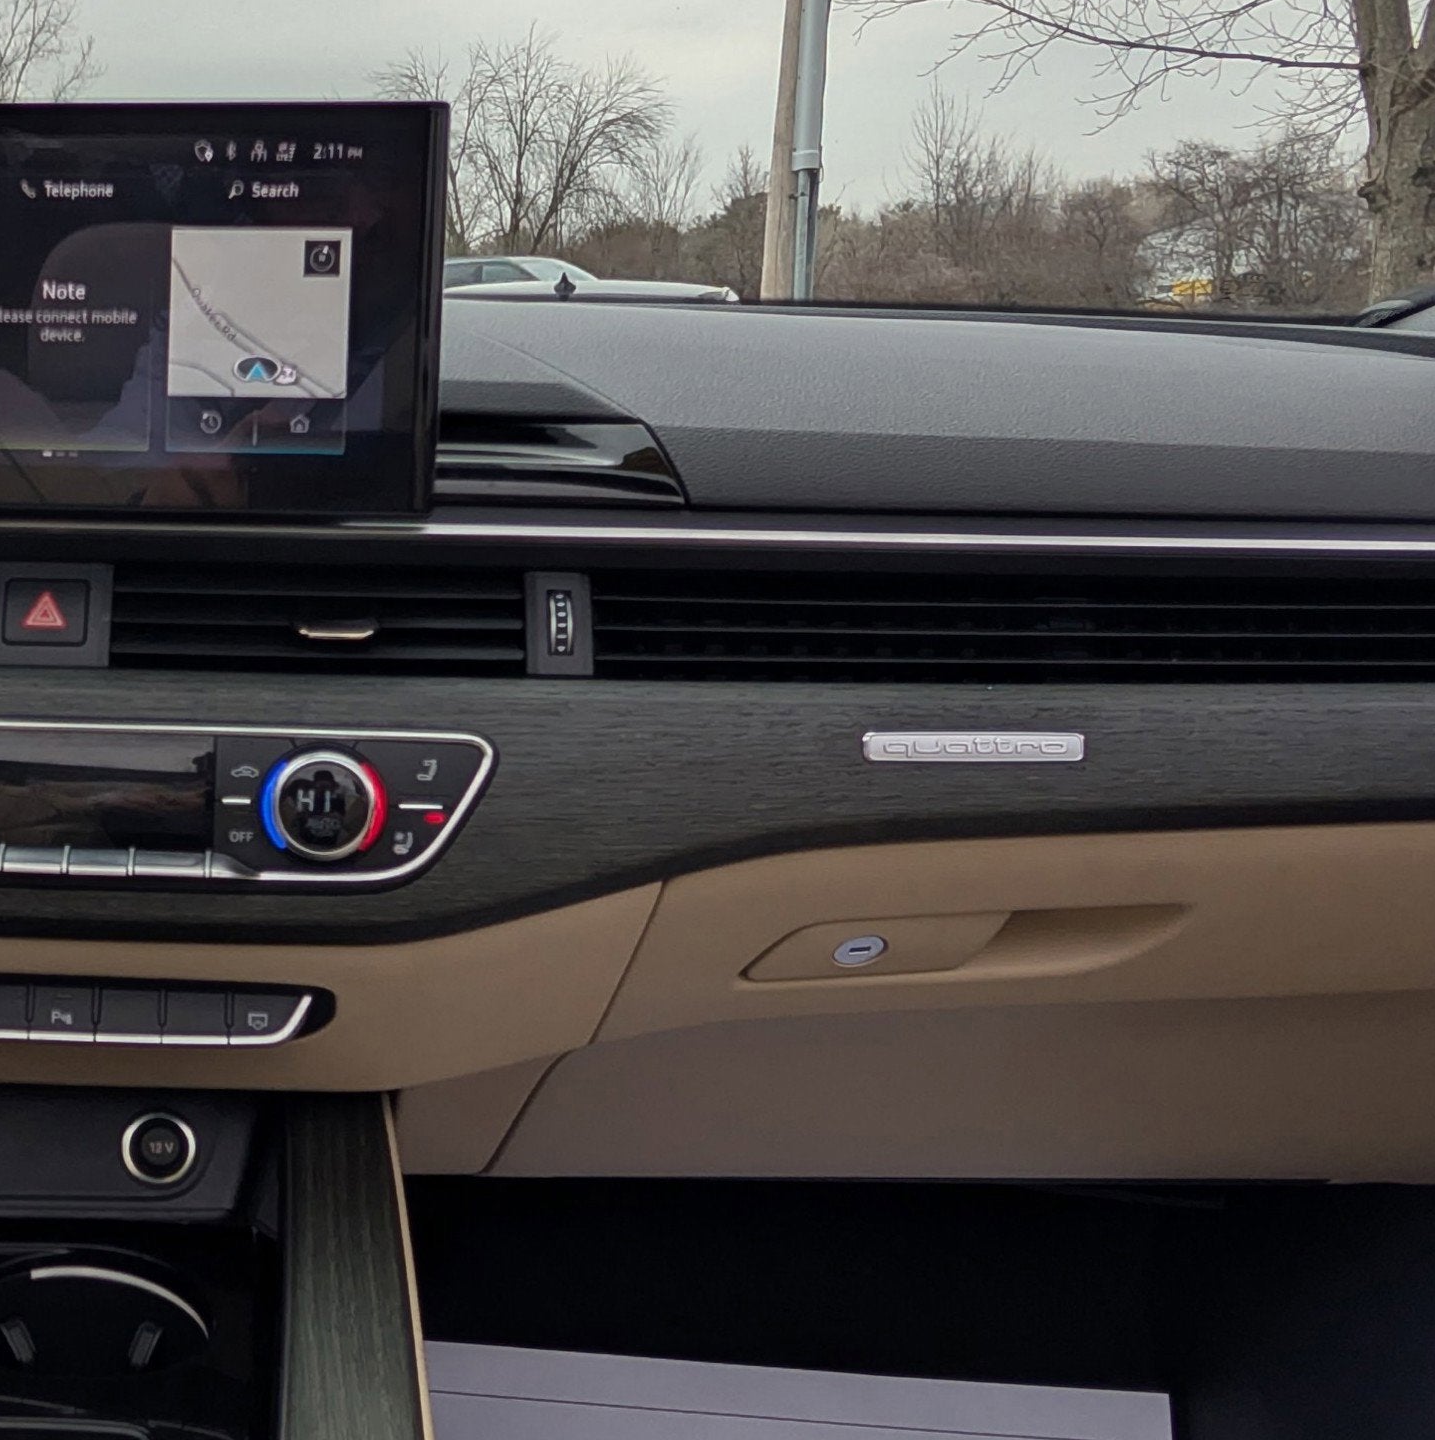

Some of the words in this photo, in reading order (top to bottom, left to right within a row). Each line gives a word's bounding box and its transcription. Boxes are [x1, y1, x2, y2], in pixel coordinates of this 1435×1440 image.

[43, 180, 114, 199] Telephone
[251, 181, 299, 198] Search
[42, 280, 86, 301] Note
[36, 309, 87, 325] connect
[92, 310, 137, 325] mobile
[40, 328, 85, 343] device.
[882, 737, 1069, 759] quattro
[296, 789, 331, 813] HI
[228, 831, 254, 843] OFF
[150, 1142, 163, 1154] 12
